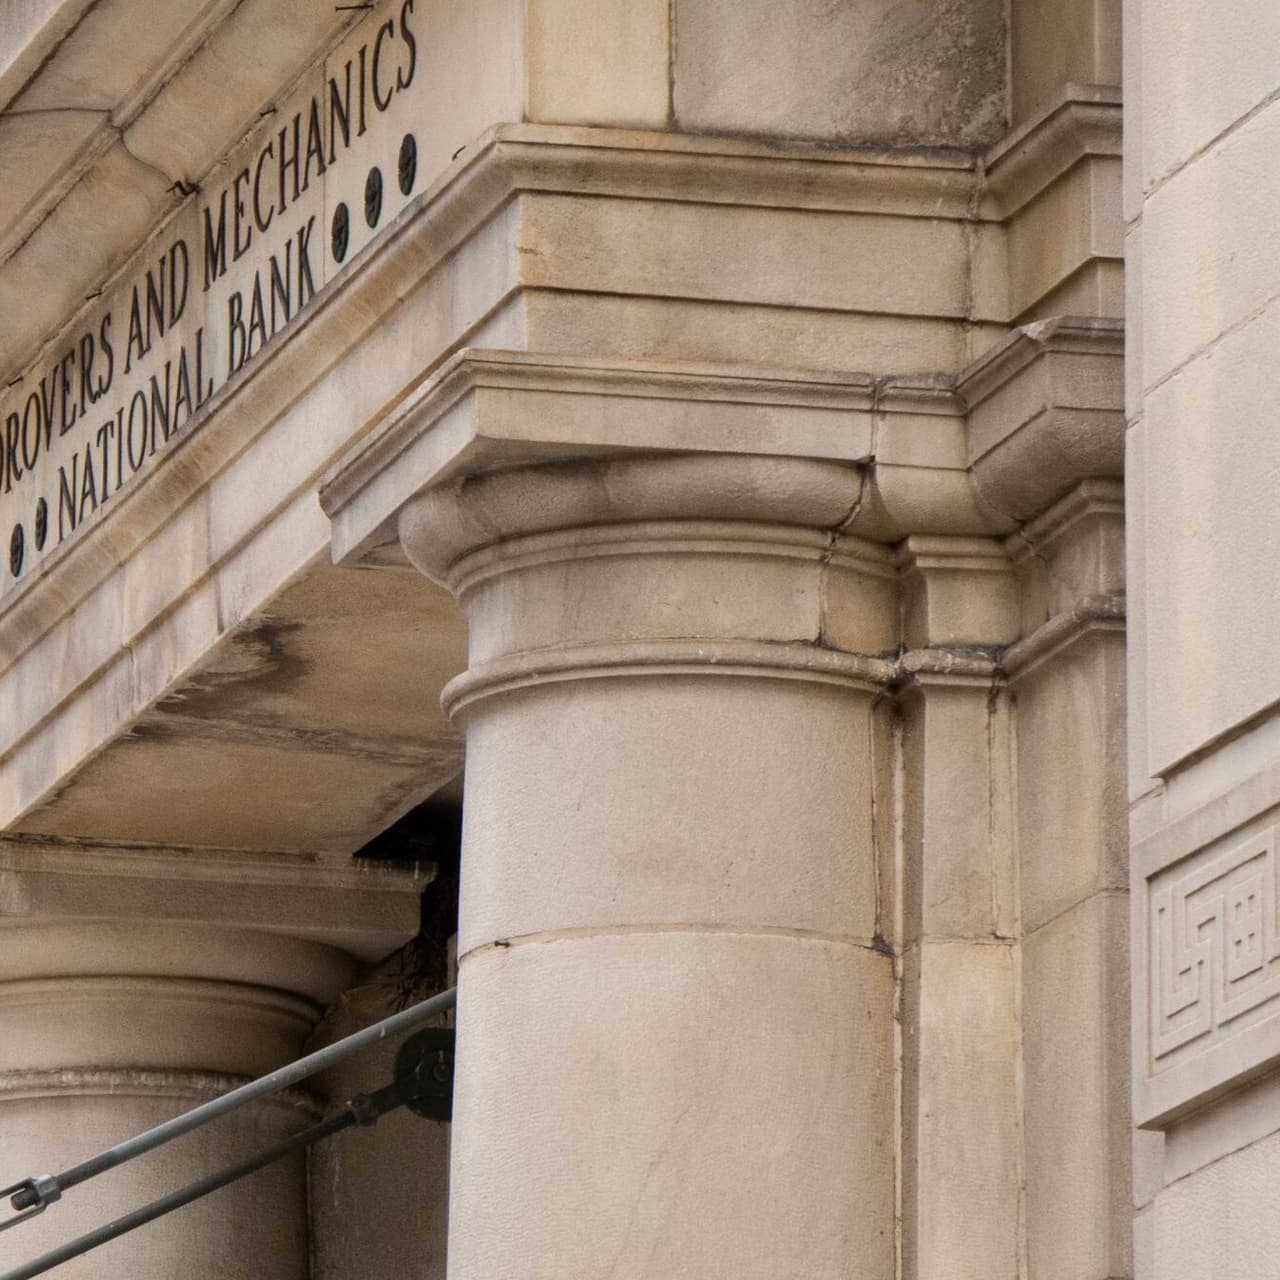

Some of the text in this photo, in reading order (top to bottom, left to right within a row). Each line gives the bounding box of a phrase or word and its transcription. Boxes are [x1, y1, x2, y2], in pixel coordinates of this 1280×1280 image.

[56, 215, 317, 545] NATIONAL BANK
[123, 239, 190, 376] AND
